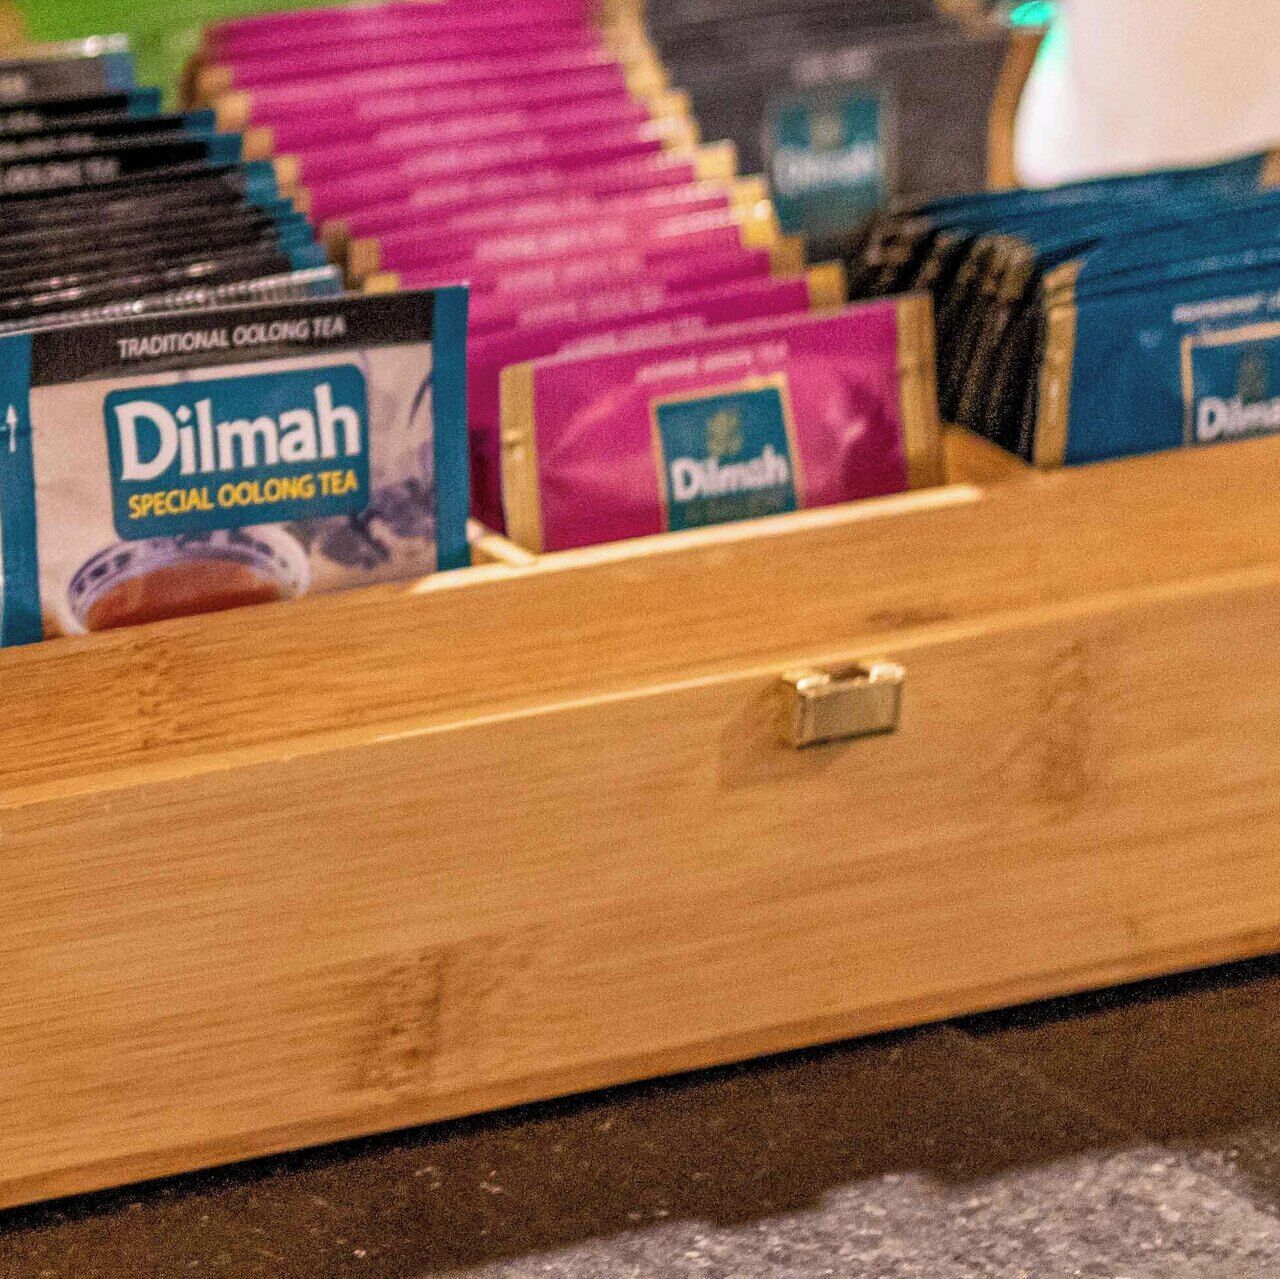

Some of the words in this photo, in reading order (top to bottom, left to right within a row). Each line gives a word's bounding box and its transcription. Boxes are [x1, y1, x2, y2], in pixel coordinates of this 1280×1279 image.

[117, 330, 229, 359] TRADITIONAL
[233, 322, 308, 347] OOLONG
[313, 315, 346, 336] TEA
[113, 382, 360, 481] Dilmah
[1197, 395, 1280, 442] Dilma
[128, 486, 214, 519] SPECIAL
[218, 474, 315, 508] OOLONG
[318, 469, 358, 496] TEA
[671, 444, 789, 503] Dilmah
